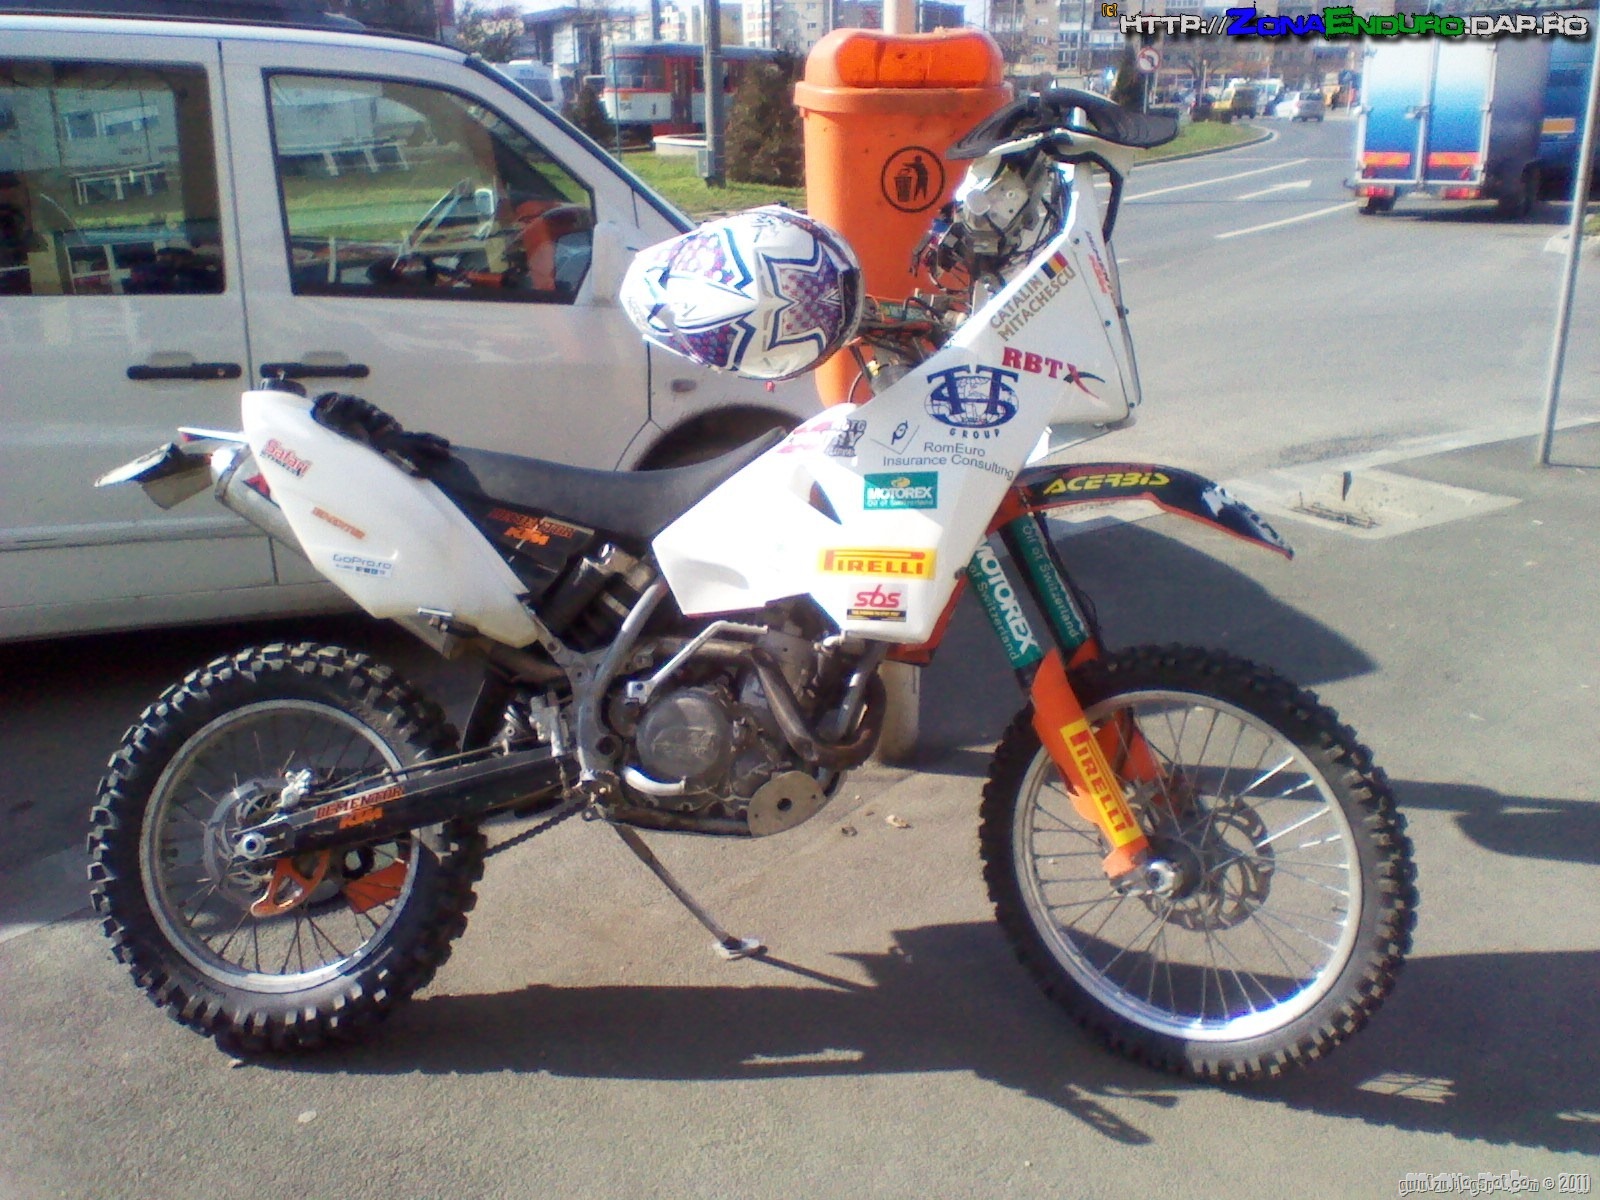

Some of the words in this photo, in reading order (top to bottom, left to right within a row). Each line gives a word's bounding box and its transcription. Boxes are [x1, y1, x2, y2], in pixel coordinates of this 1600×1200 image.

[990, 275, 1043, 329] CATALIN
[998, 266, 1076, 341] MITACHESCU
[949, 428, 1000, 440] GROUP
[923, 442, 986, 457] RomEuro
[883, 455, 947, 467] Insurance
[951, 454, 1014, 481] Consulting
[867, 487, 933, 500] MOTOREX
[1043, 472, 1171, 495] ACERBIS
[823, 549, 926, 575] PIRELLI
[1039, 564, 1080, 638] Switzerland
[977, 582, 1020, 660] Switzerland
[1070, 730, 1135, 833] PIRELLI
